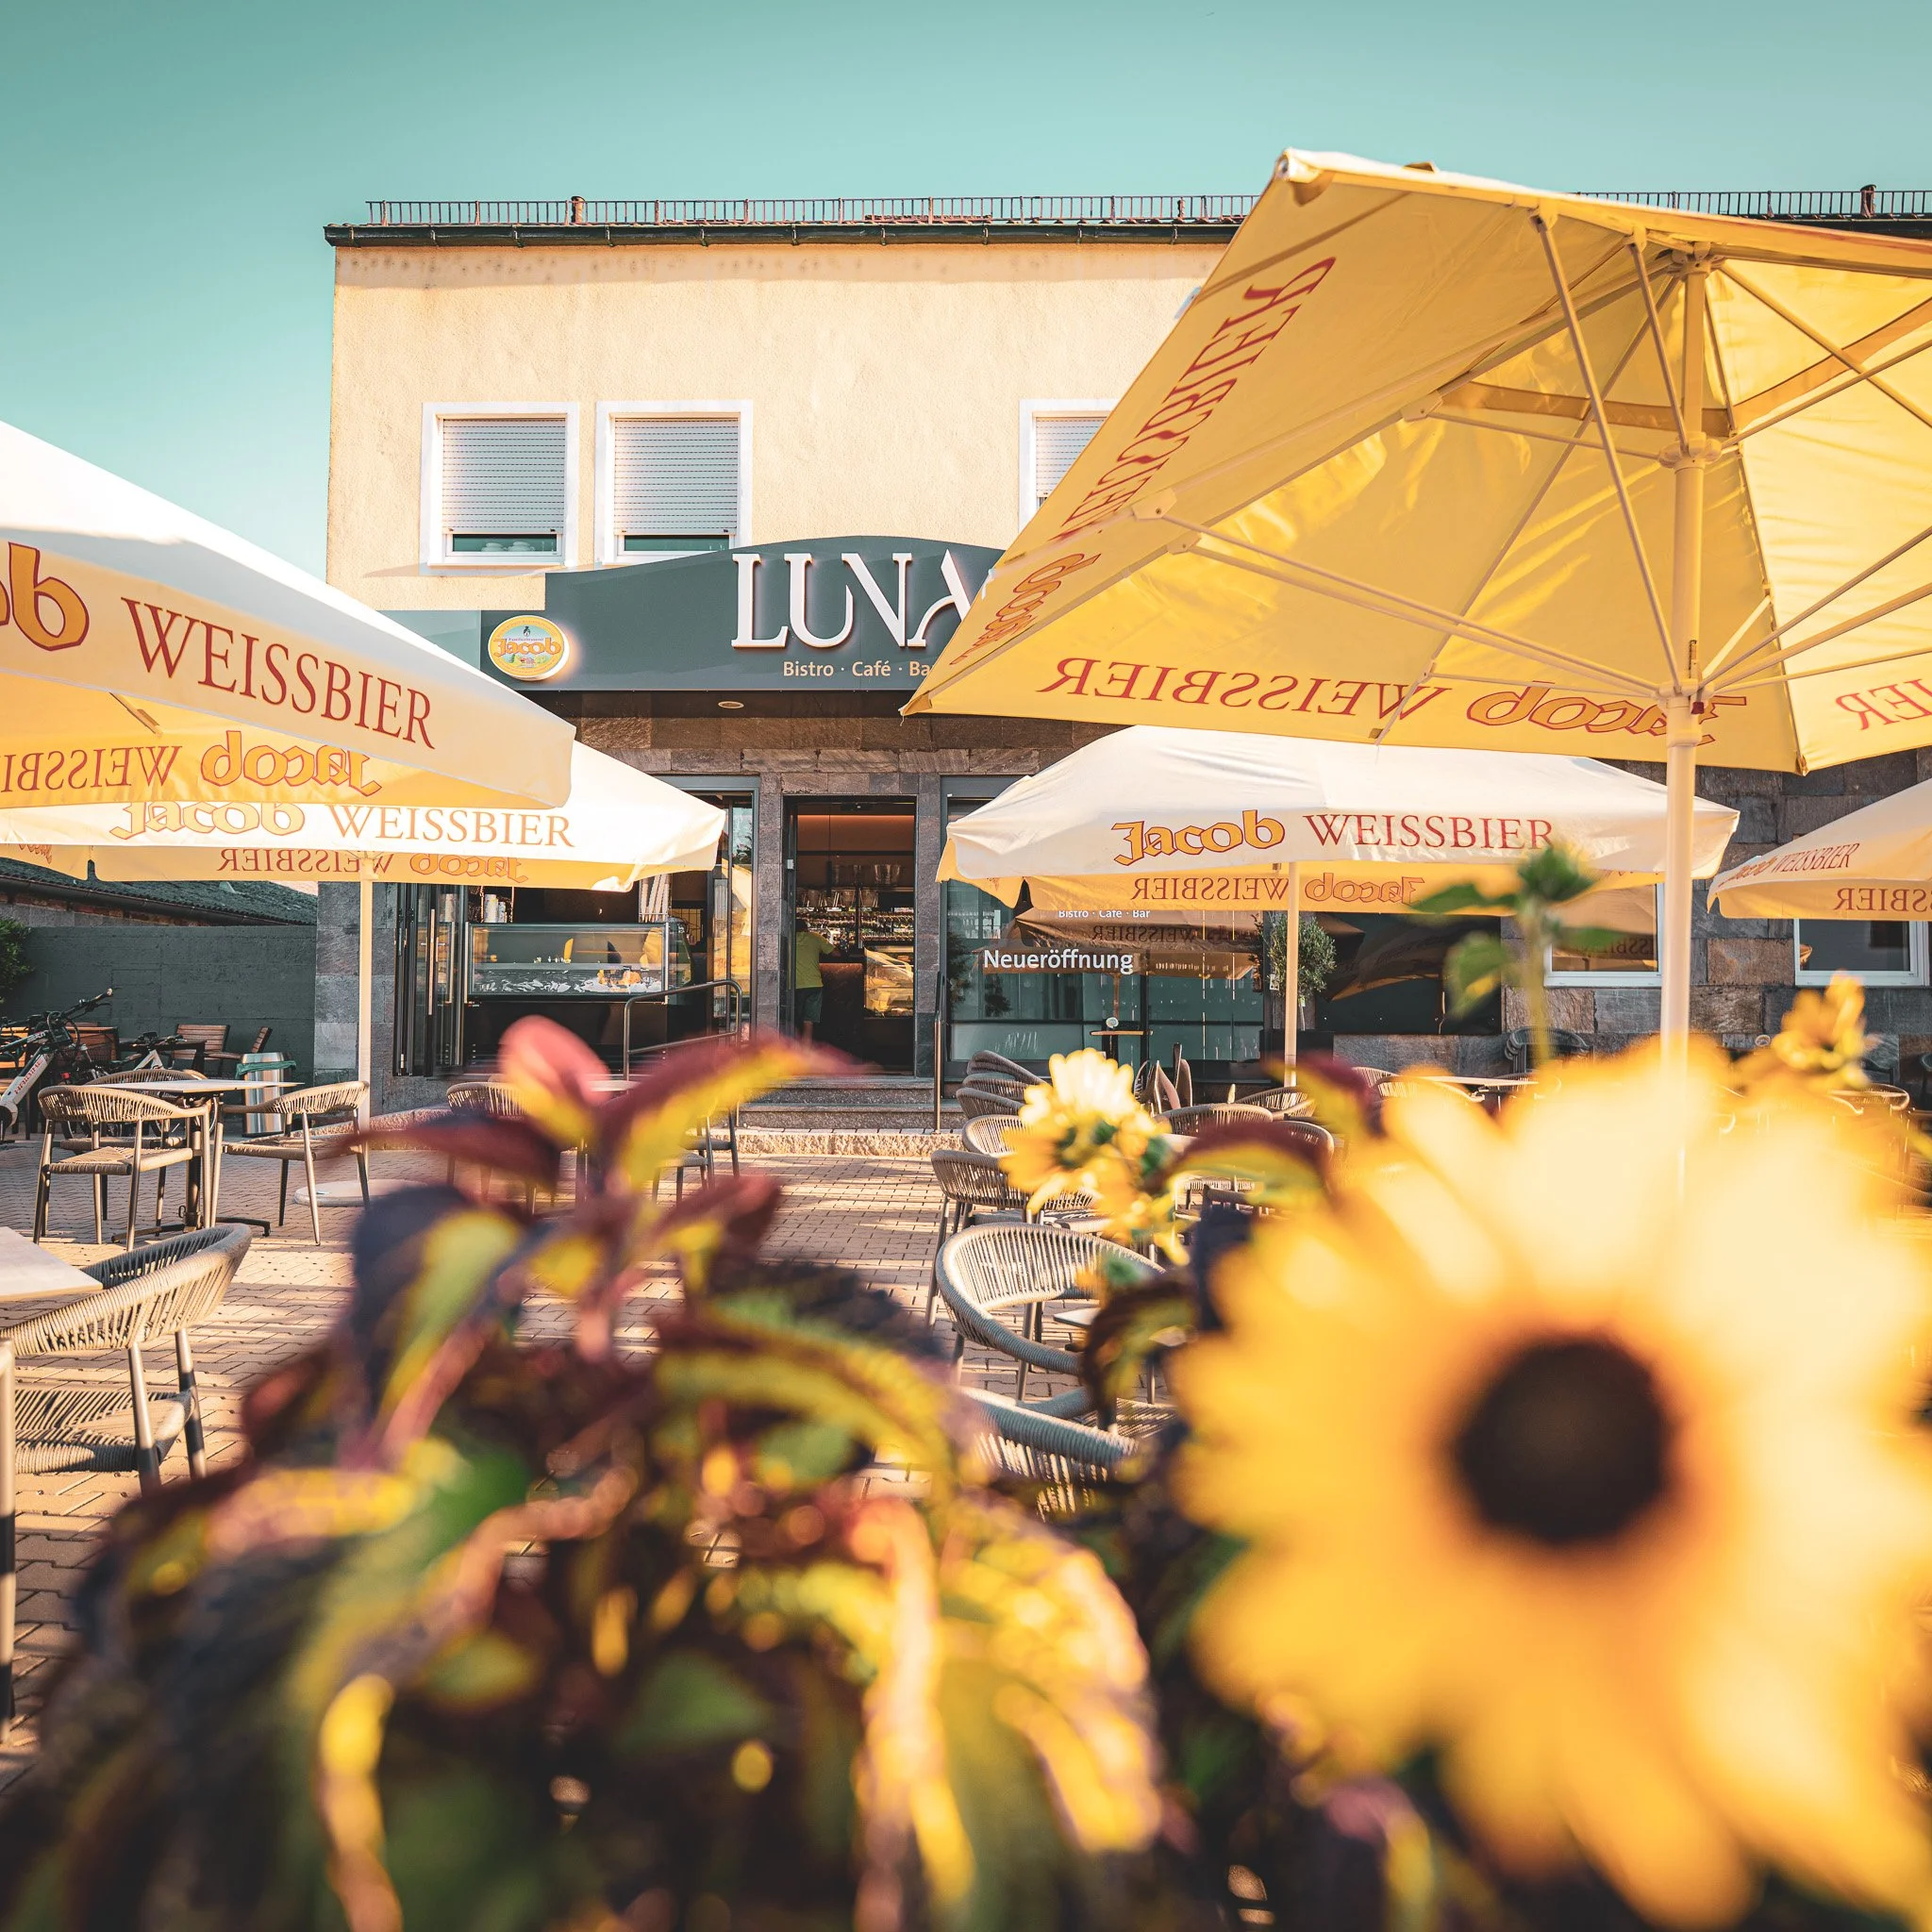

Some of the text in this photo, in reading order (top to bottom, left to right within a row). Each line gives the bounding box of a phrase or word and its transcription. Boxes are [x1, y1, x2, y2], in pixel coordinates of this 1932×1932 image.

[731, 549, 972, 649] LUNA
[492, 637, 562, 658] Jacob
[783, 660, 933, 677] Bistro Café Ba
[121, 596, 437, 750] WEISSBIER
[108, 802, 575, 848] Jacob WEISSBIER
[1111, 809, 1555, 867] Jacob WEISSBIER
[983, 948, 1134, 975] Neueröffnung
